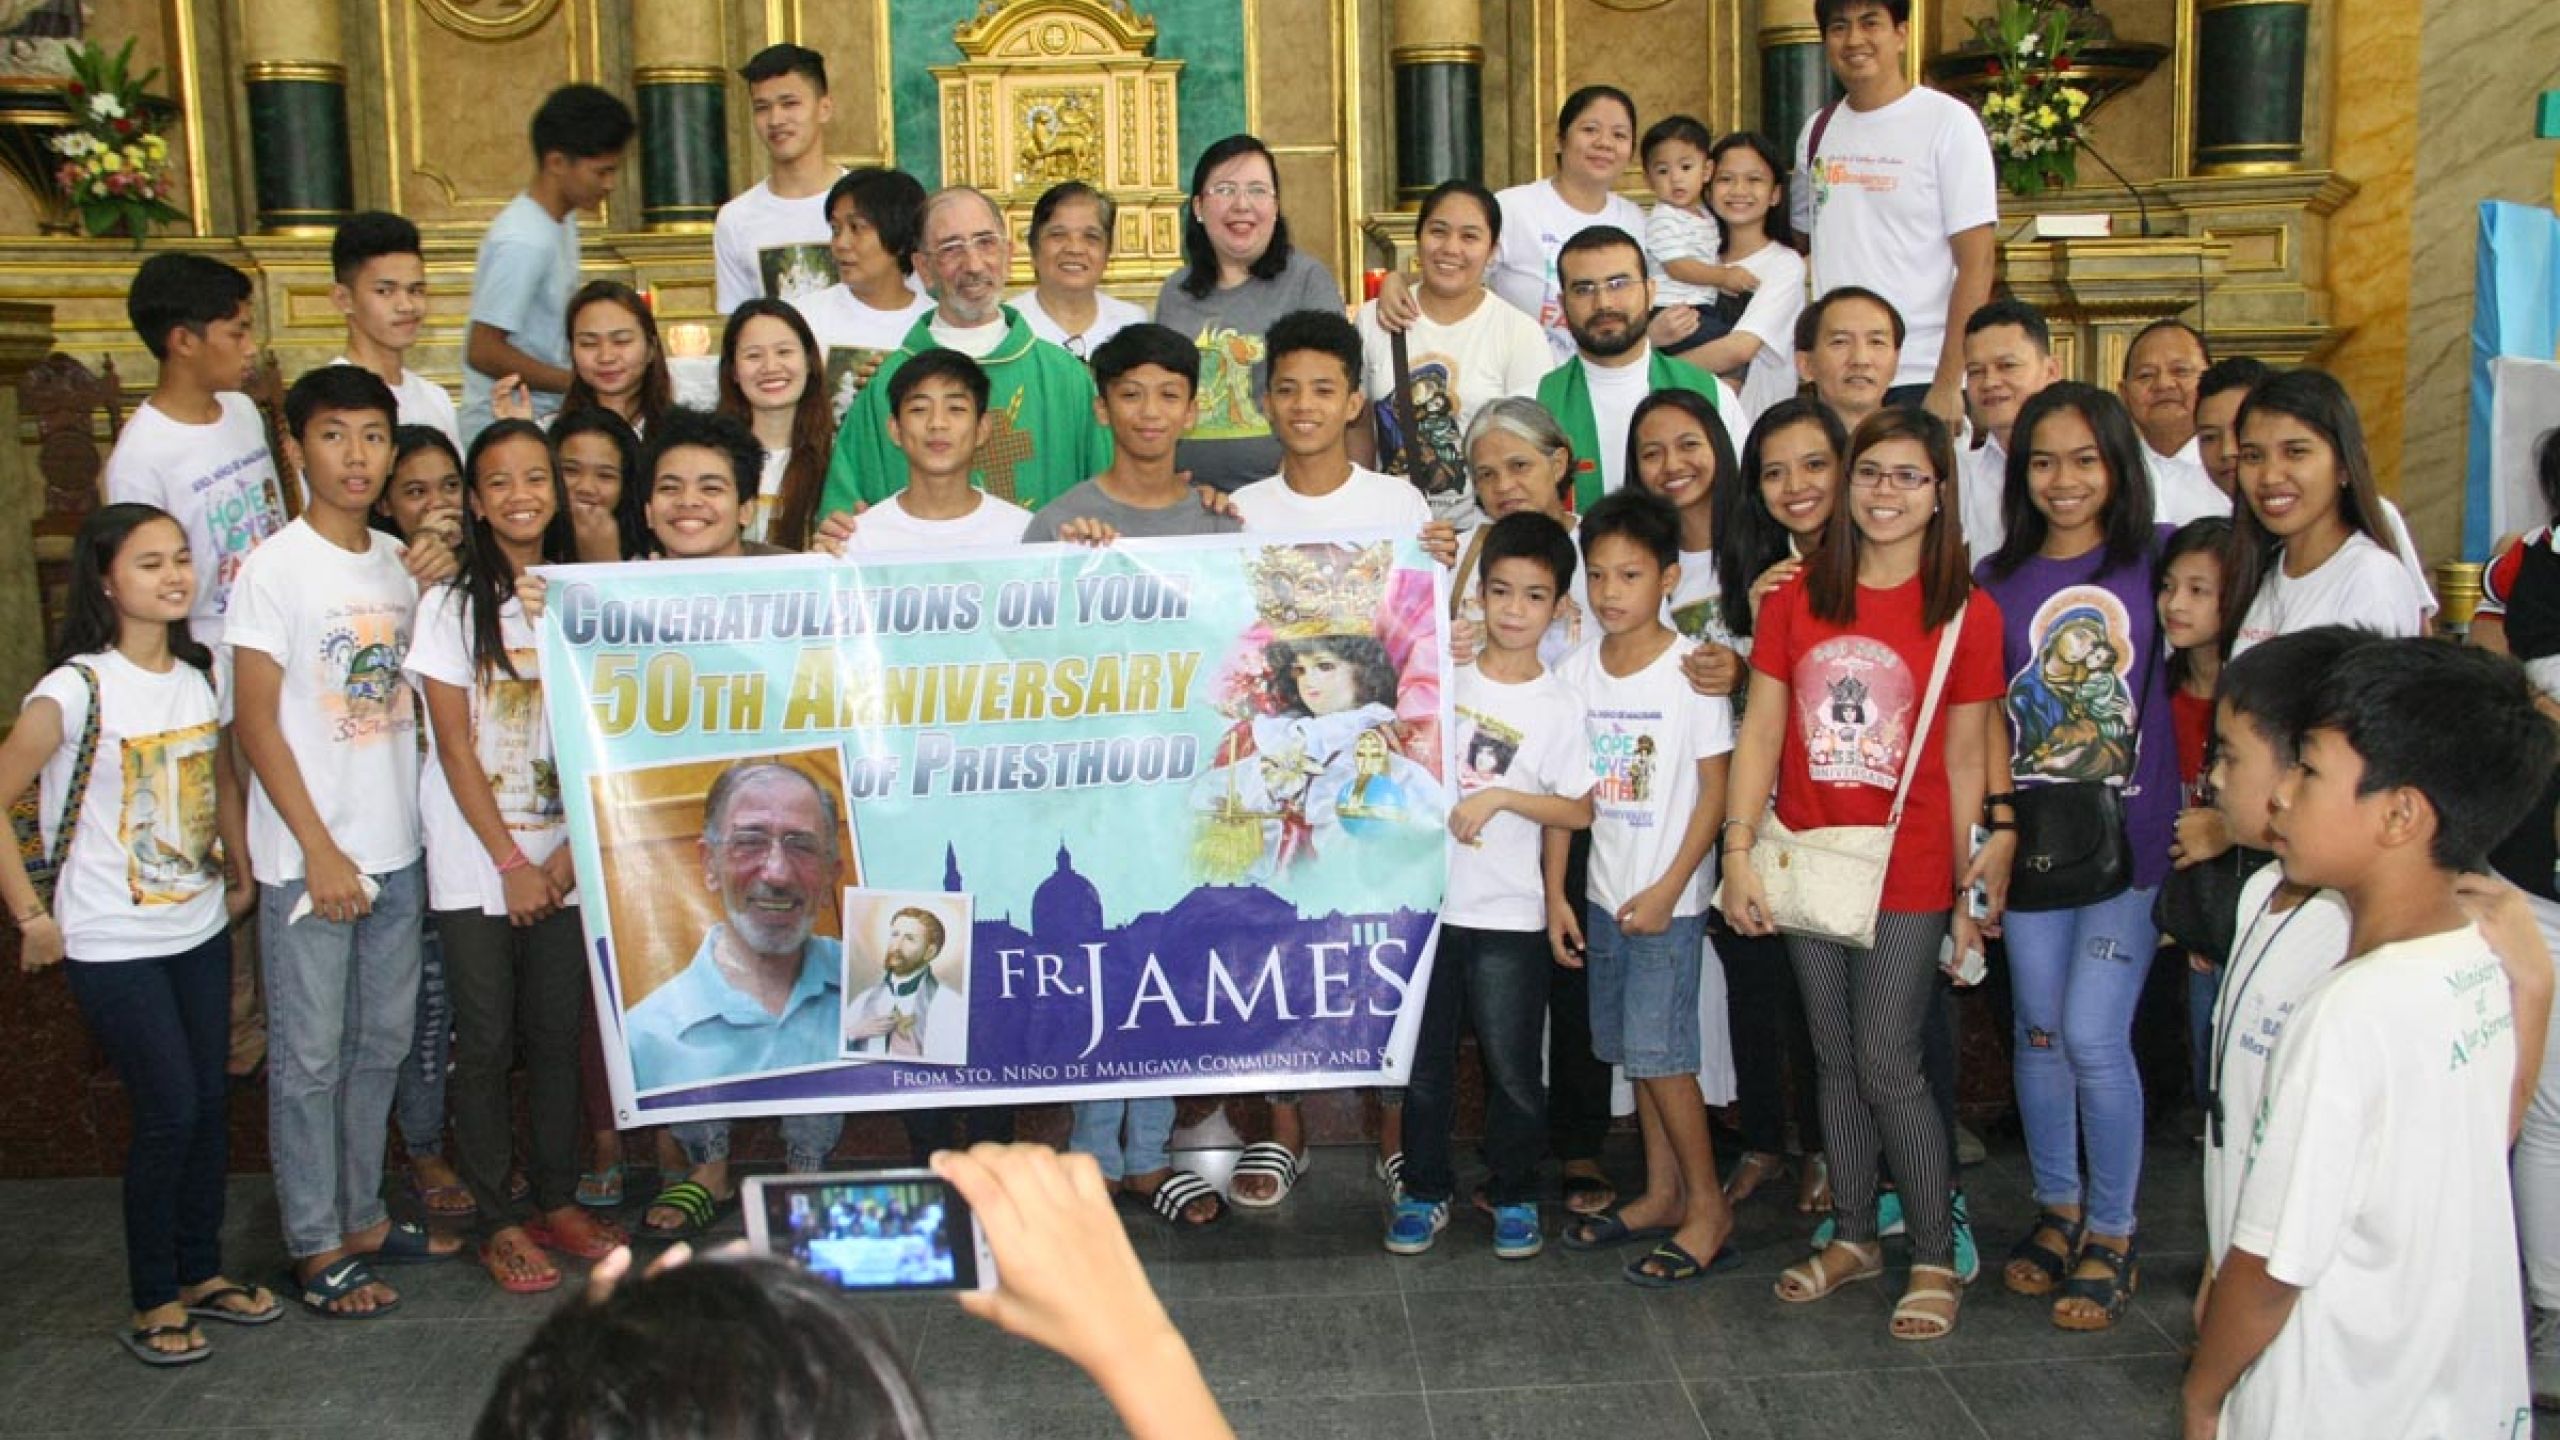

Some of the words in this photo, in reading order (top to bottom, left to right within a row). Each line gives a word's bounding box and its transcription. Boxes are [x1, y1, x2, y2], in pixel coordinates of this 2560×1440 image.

[562, 582, 981, 645] CONGRATULATIONS
[998, 580, 1060, 631] ON
[1076, 573, 1190, 624] YOUR
[592, 651, 768, 735] 50TH
[783, 647, 1201, 731] ANNIVERSARY
[852, 756, 899, 798] OF
[913, 732, 1199, 797] PRIESTHOOD
[995, 948, 1085, 998] FR.
[1076, 937, 1409, 1058] JAMES
[892, 1069, 948, 1087] FROM
[955, 1067, 997, 1084] STO.
[1003, 1063, 1058, 1082] NIÑO
[1065, 1063, 1089, 1079] DE
[1096, 1057, 1192, 1077] MALIGAYA
[1199, 1051, 1322, 1072] COMMUNITY
[1328, 1048, 1371, 1064] AND
